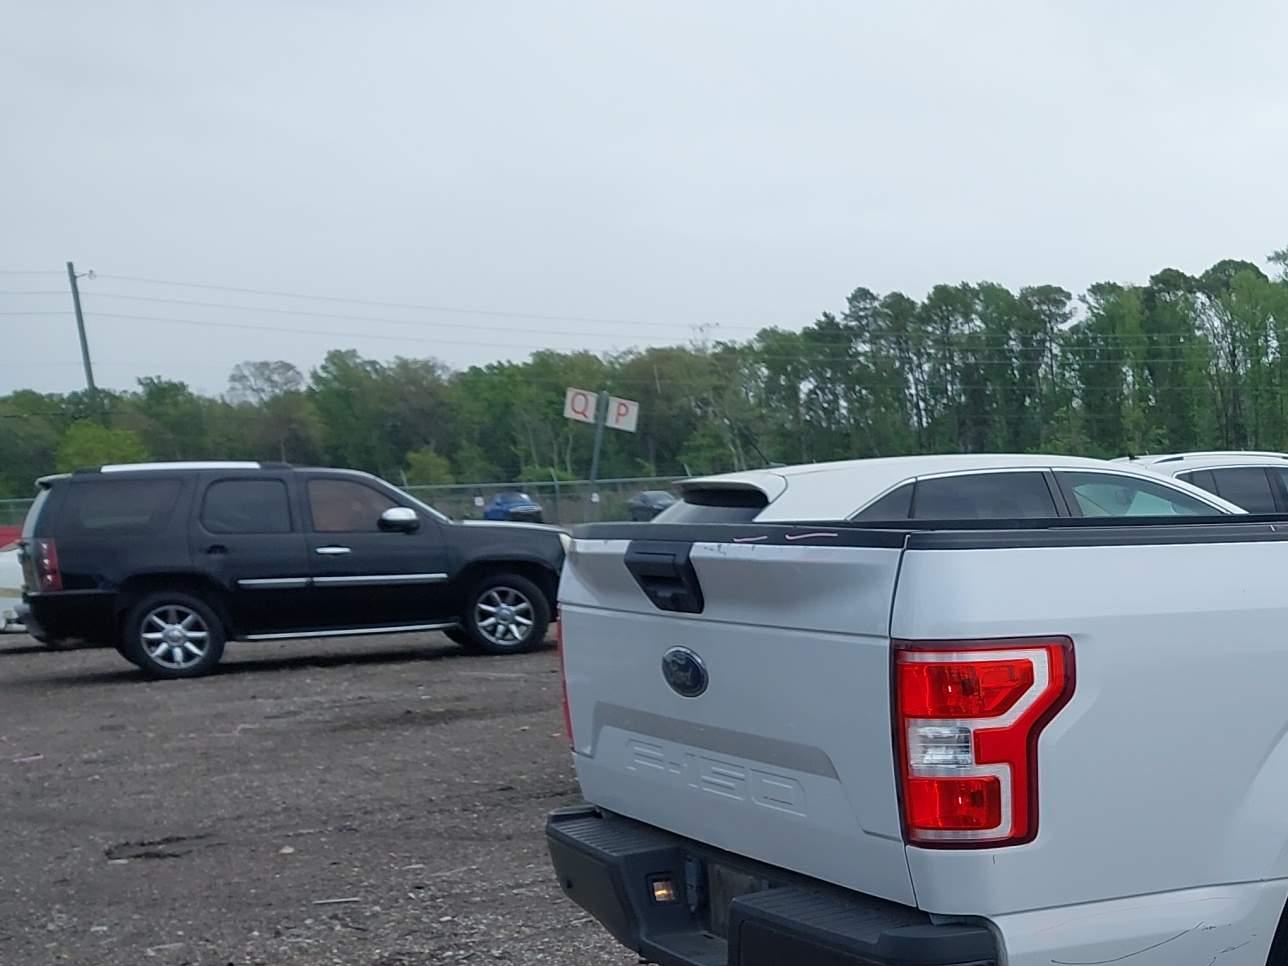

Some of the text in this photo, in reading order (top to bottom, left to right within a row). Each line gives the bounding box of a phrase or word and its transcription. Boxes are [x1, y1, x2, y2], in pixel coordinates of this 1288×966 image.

[570, 391, 589, 418] Q
[614, 402, 630, 425] P
[626, 738, 808, 818] F-150
